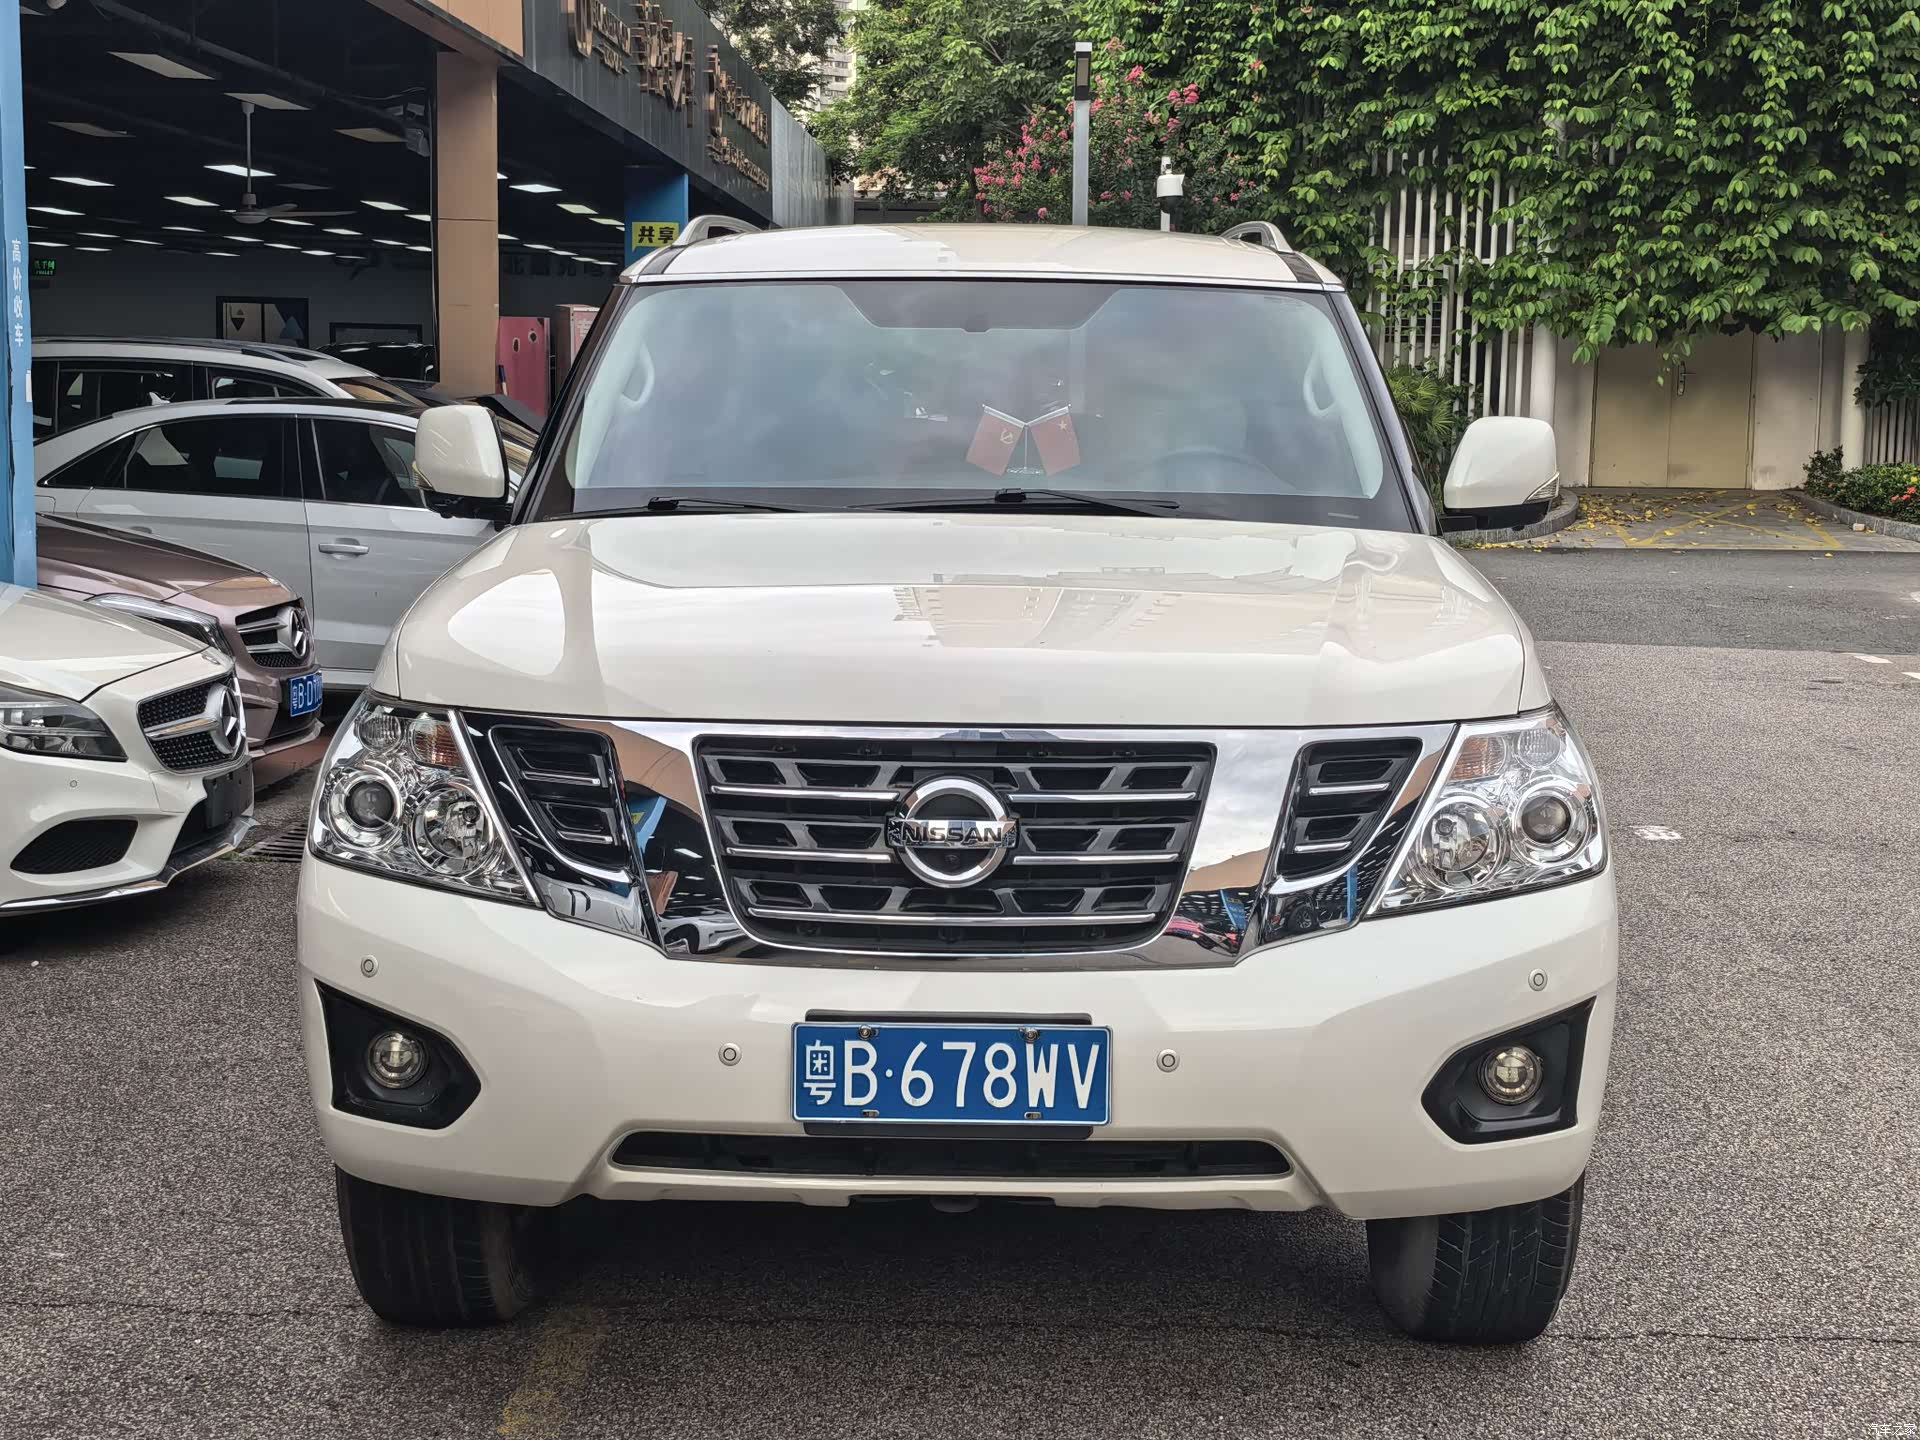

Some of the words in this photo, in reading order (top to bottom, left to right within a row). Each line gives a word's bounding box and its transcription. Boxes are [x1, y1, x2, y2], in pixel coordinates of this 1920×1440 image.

[638, 226, 675, 244] 共享
[12, 238, 24, 347] 高价收车
[902, 827, 1001, 843] NISSAN
[803, 1039, 1100, 1109] 粤B·678WV
